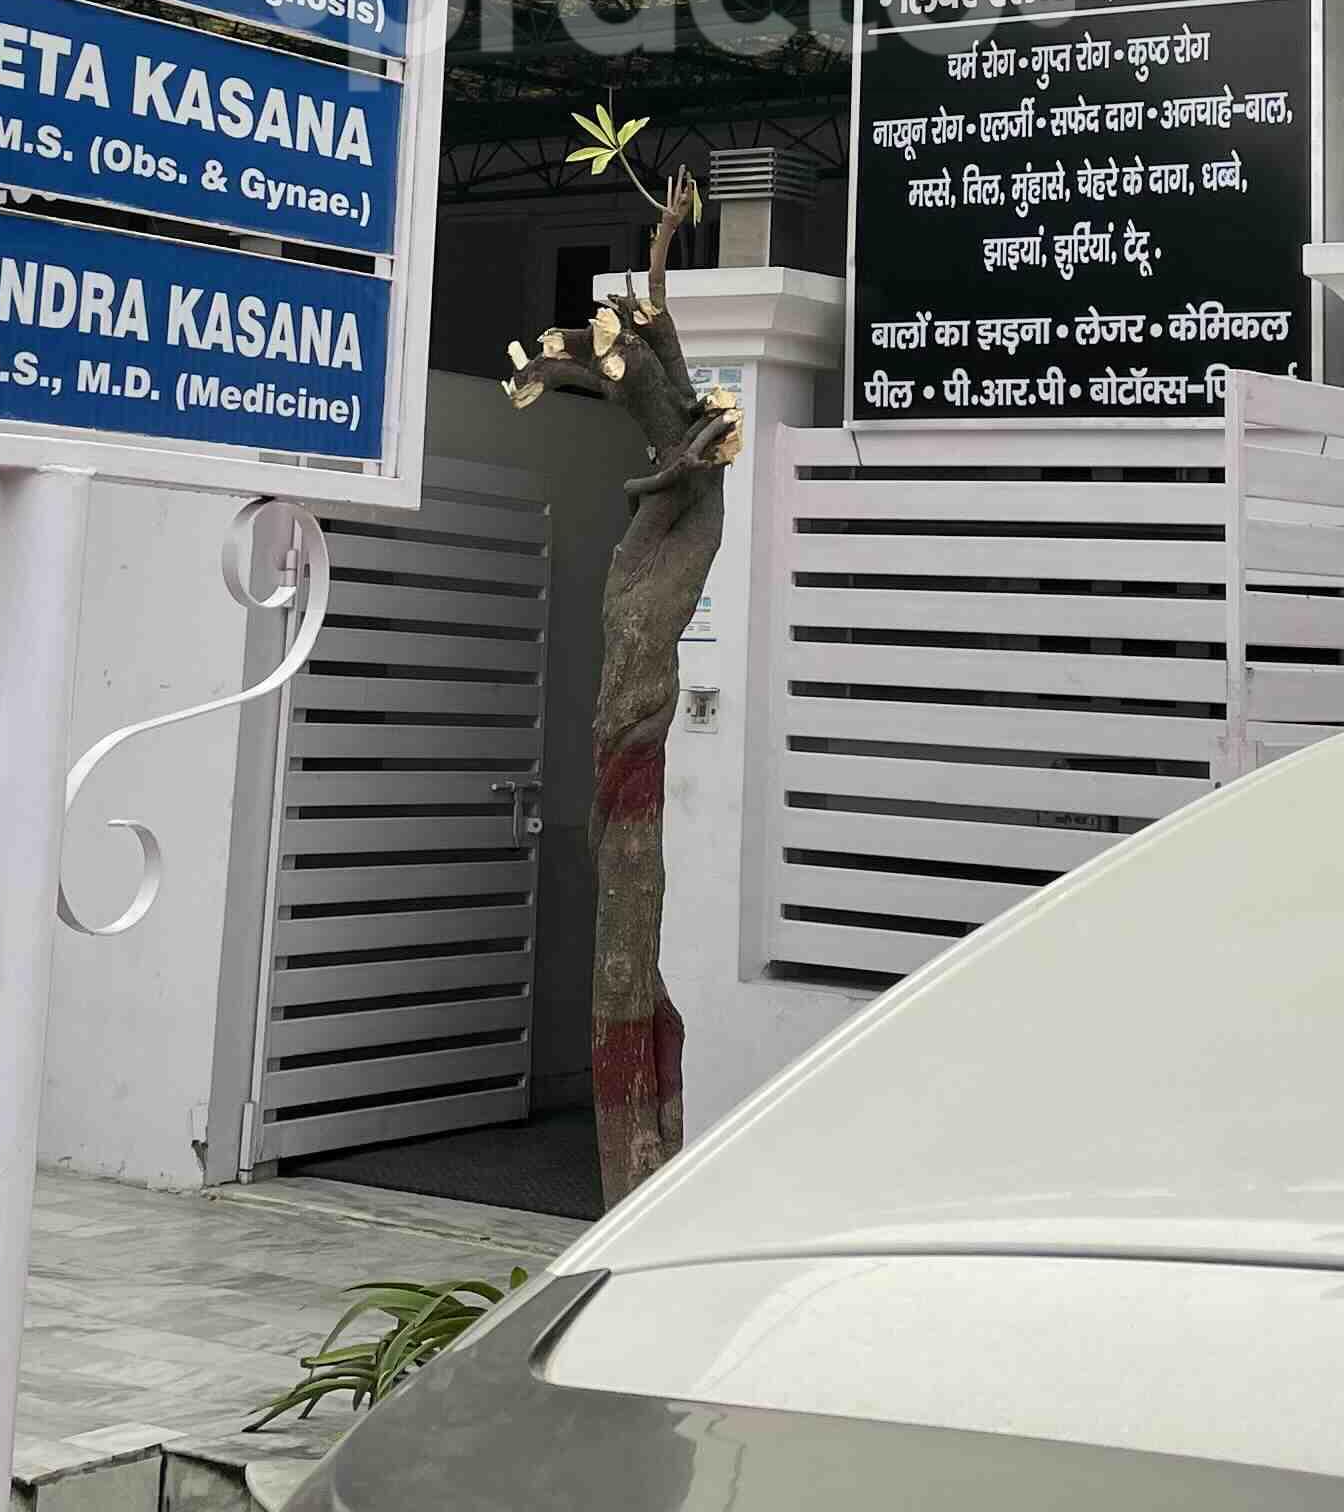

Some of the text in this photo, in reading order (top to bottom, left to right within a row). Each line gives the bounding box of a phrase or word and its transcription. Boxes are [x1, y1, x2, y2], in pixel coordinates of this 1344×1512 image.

[946, 21, 1212, 91] चर्म रोग गुप्त रोग कुष्ठ रोग
[131, 54, 374, 168] KASANA
[871, 82, 1294, 161] नाखून रोग एलर्जी सफेद दाग अनचाहे-बाल,
[88, 134, 189, 186] (Obs.
[200, 158, 229, 194] &
[239, 166, 372, 228] Gynae.)
[907, 148, 1249, 219] मस्से, तिल, मुंहासे, चेहरे के दाग, धब्बे,
[981, 223, 1048, 273] झाइयां,
[165, 283, 364, 373] KASANA
[869, 299, 1293, 357] बालों का झड़ना लेजर केमिकल
[76, 358, 161, 402] M.D.
[174, 372, 362, 433] (Medicine)
[862, 368, 917, 410] पील
[941, 365, 1068, 408] पी.आर.पी
